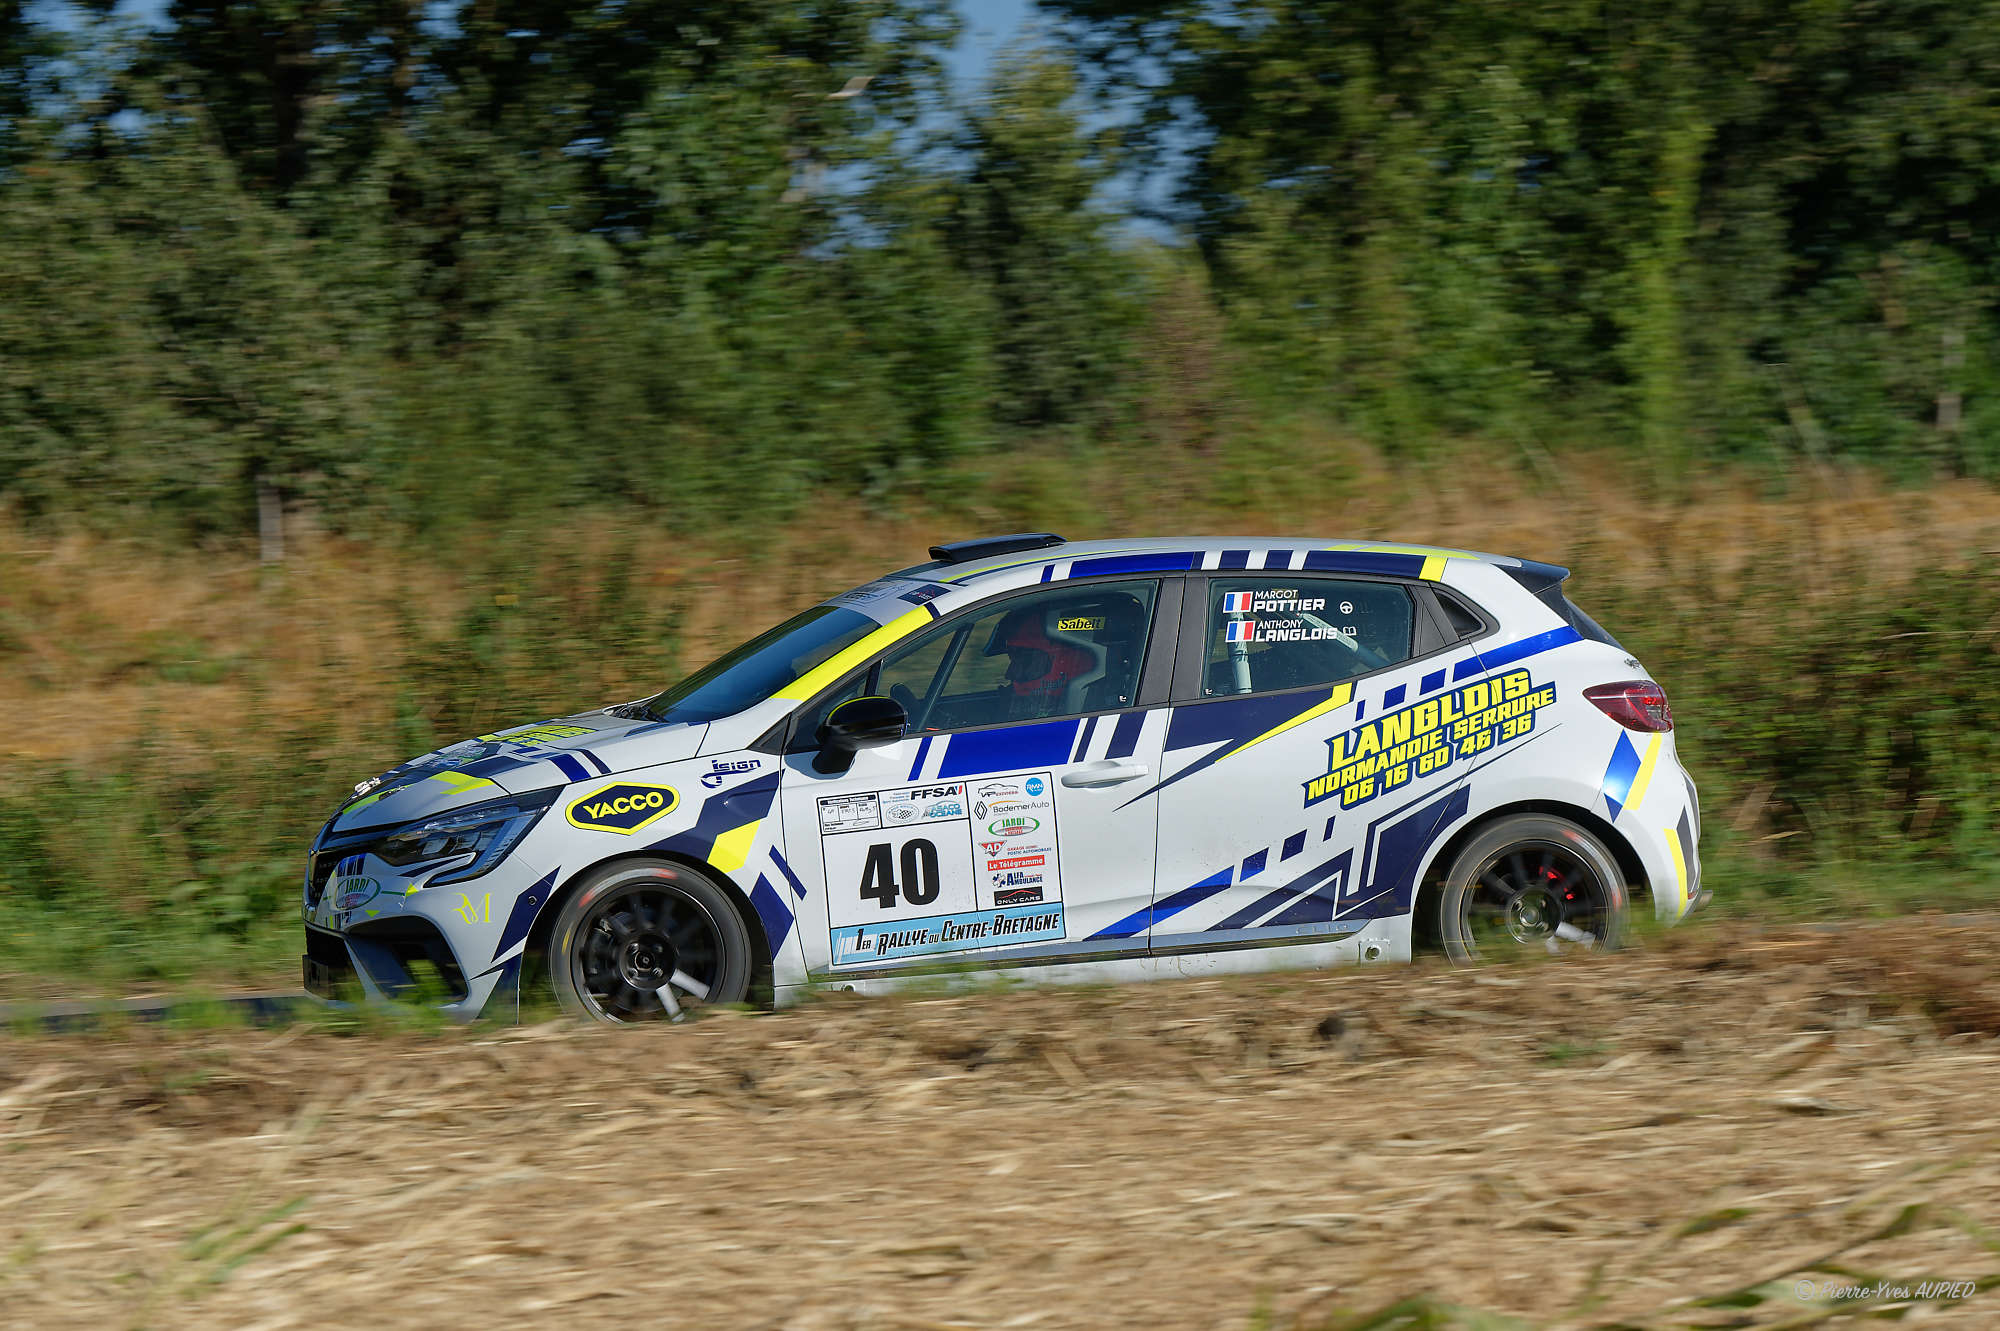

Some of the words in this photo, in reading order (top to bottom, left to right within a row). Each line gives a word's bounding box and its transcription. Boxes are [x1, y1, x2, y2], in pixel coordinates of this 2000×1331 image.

[1254, 590, 1298, 600] MARGOT
[1253, 599, 1326, 612] POTTIER
[1257, 619, 1304, 630] ANTHONY
[1255, 628, 1338, 642] LANGLOIS
[1331, 670, 1530, 771] LANGLOIS
[1308, 728, 1443, 801] NORMANDIE
[1453, 687, 1555, 741] SERRURE
[1343, 776, 1375, 806] 06
[1384, 762, 1410, 789] 16
[1418, 745, 1450, 775] 60
[1459, 730, 1492, 755] 46
[1501, 713, 1533, 742] 36
[911, 787, 957, 800] FFSA
[583, 791, 664, 820] YACCO
[1002, 817, 1025, 828] JARDI
[986, 842, 1001, 853] AD
[999, 857, 1043, 868] Télégramme
[859, 838, 941, 909] 40
[1019, 895, 1041, 903] CARS
[877, 928, 929, 955] RALLYE
[941, 913, 1061, 943] CENTRE-BRETAGNE
